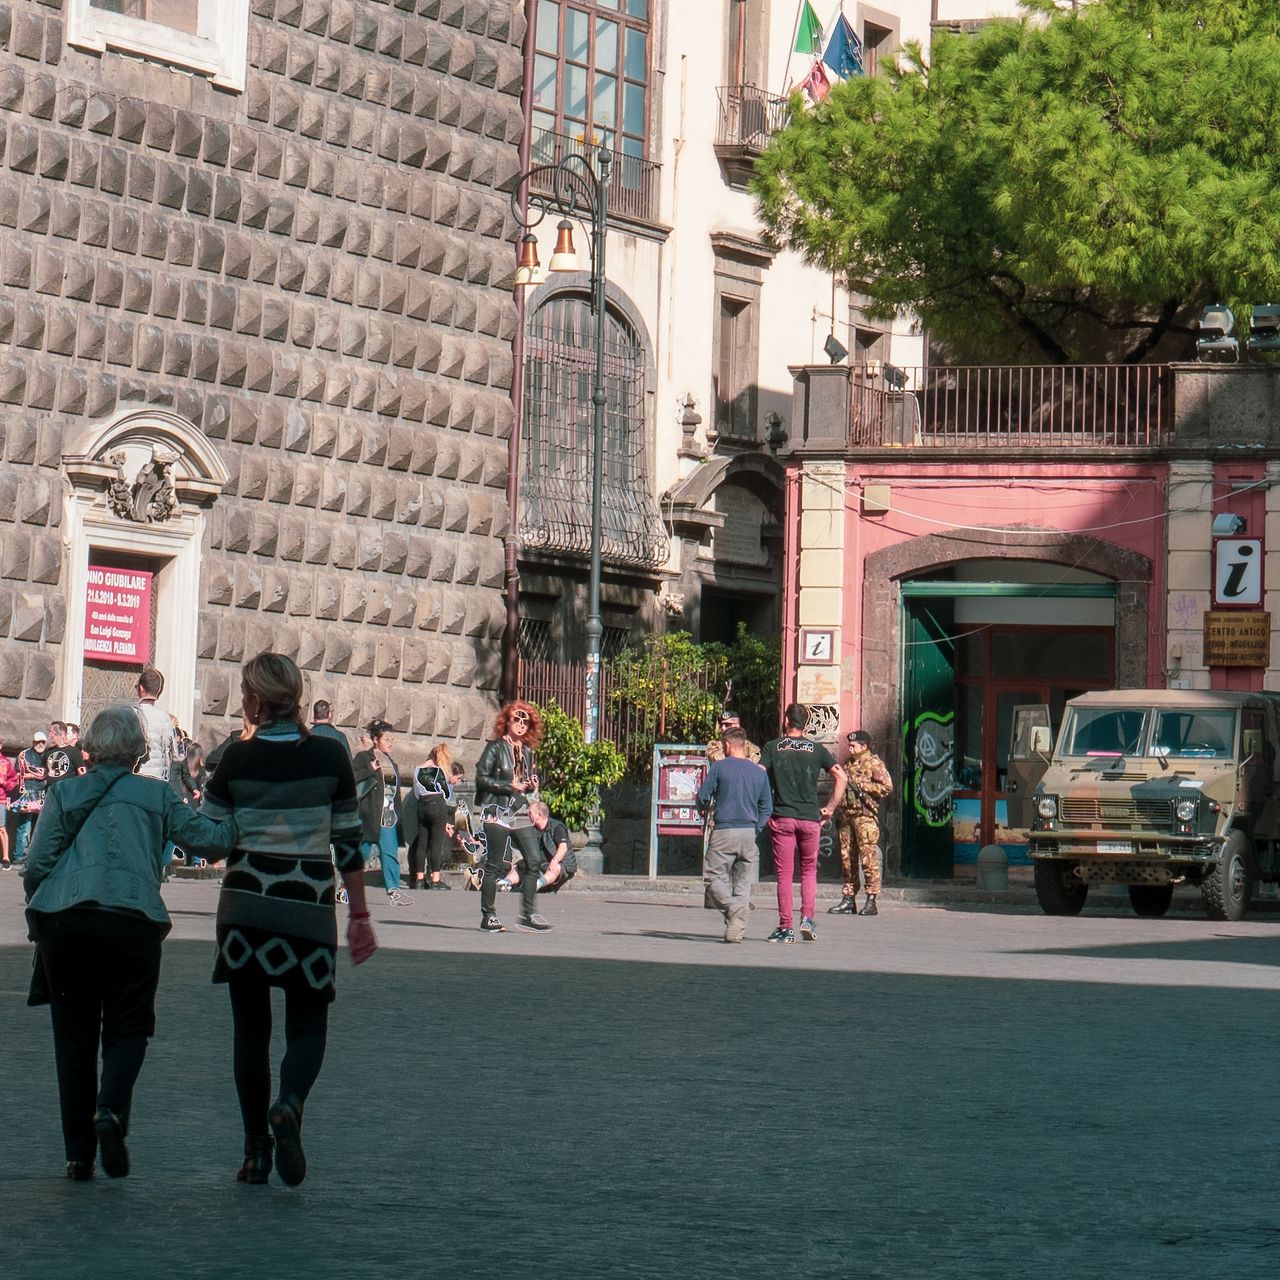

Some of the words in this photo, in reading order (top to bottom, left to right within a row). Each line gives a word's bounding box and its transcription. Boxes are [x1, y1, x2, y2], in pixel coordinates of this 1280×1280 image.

[87, 570, 103, 585] NNO
[105, 573, 146, 591] GIUBILARE
[100, 625, 111, 638] Luigi
[1207, 627, 1235, 636] CENTRO
[1239, 627, 1266, 636] ANTICO
